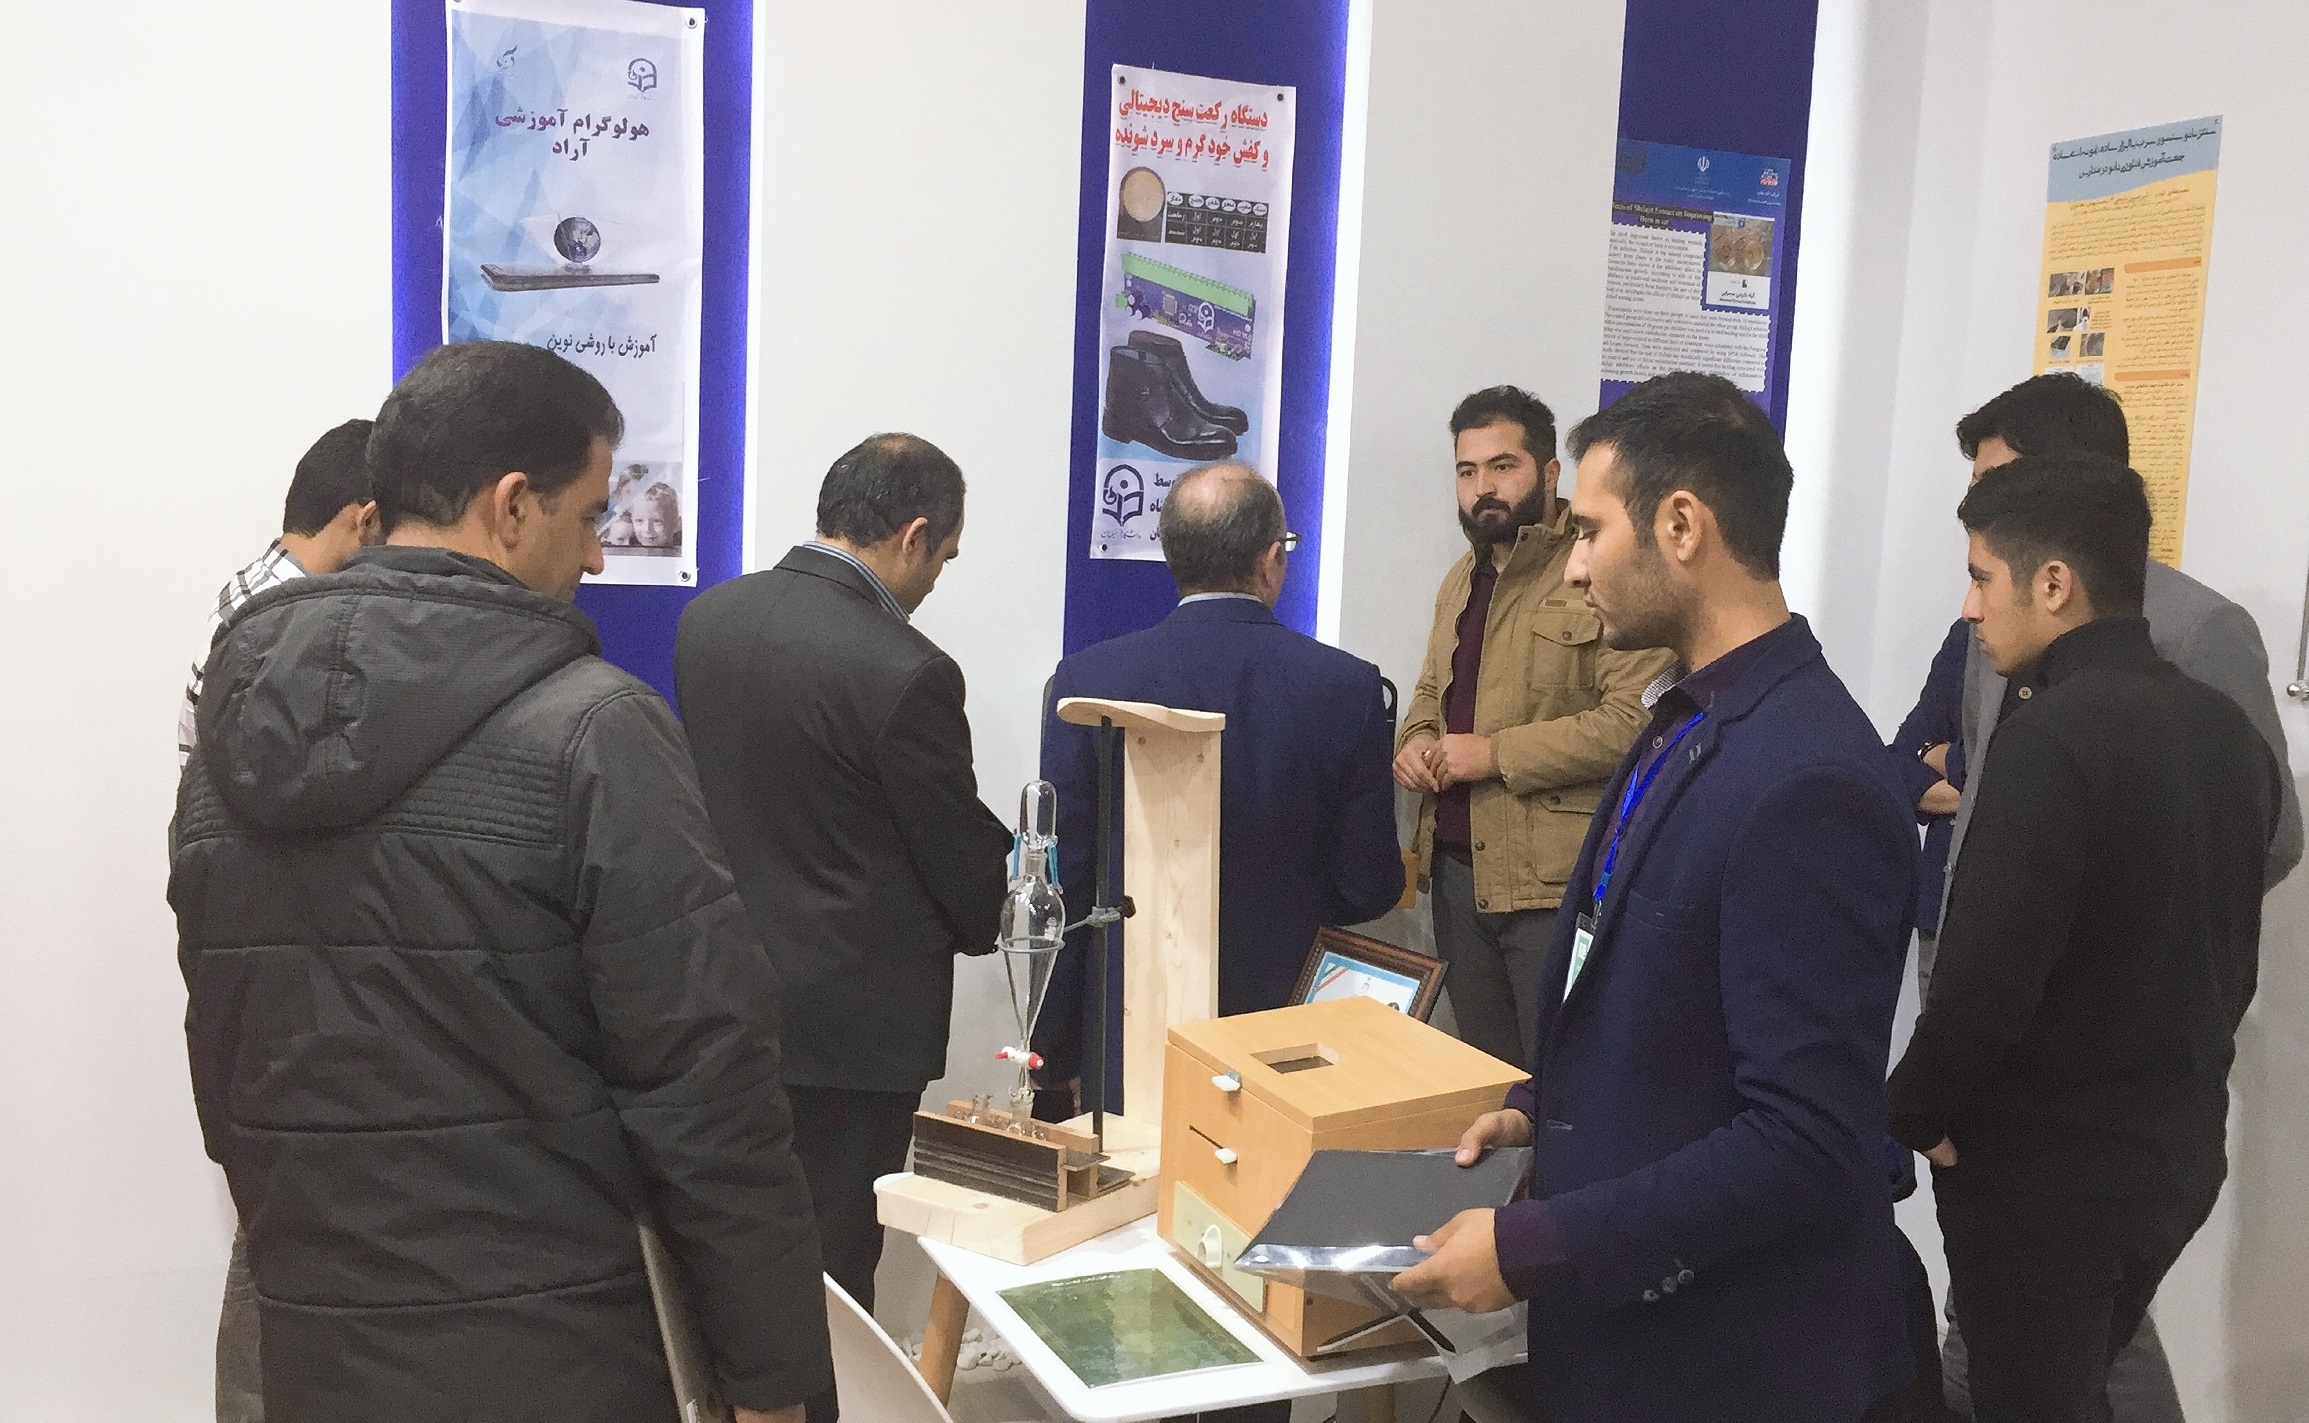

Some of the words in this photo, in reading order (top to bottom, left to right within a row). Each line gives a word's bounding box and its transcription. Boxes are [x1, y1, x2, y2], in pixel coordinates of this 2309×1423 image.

[1119, 89, 1170, 117] دیجیتالی
[1171, 99, 1195, 123] سنج
[1195, 101, 1228, 130] رکعت
[495, 106, 569, 131] آموزشی
[573, 113, 650, 141] هولوگرام
[1230, 104, 1268, 128] دستگاه
[552, 137, 591, 161] آراد
[1115, 123, 1148, 152] شونده
[1150, 130, 1174, 155] سرد
[1175, 137, 1183, 157] و
[1185, 133, 1206, 159] گرم
[1208, 136, 1231, 162] خود
[1233, 138, 1261, 164] کفش
[1261, 149, 1269, 168] و
[546, 333, 573, 353] نوین
[575, 333, 606, 357] روشی
[608, 335, 616, 354] با
[618, 333, 657, 359] آموزش
